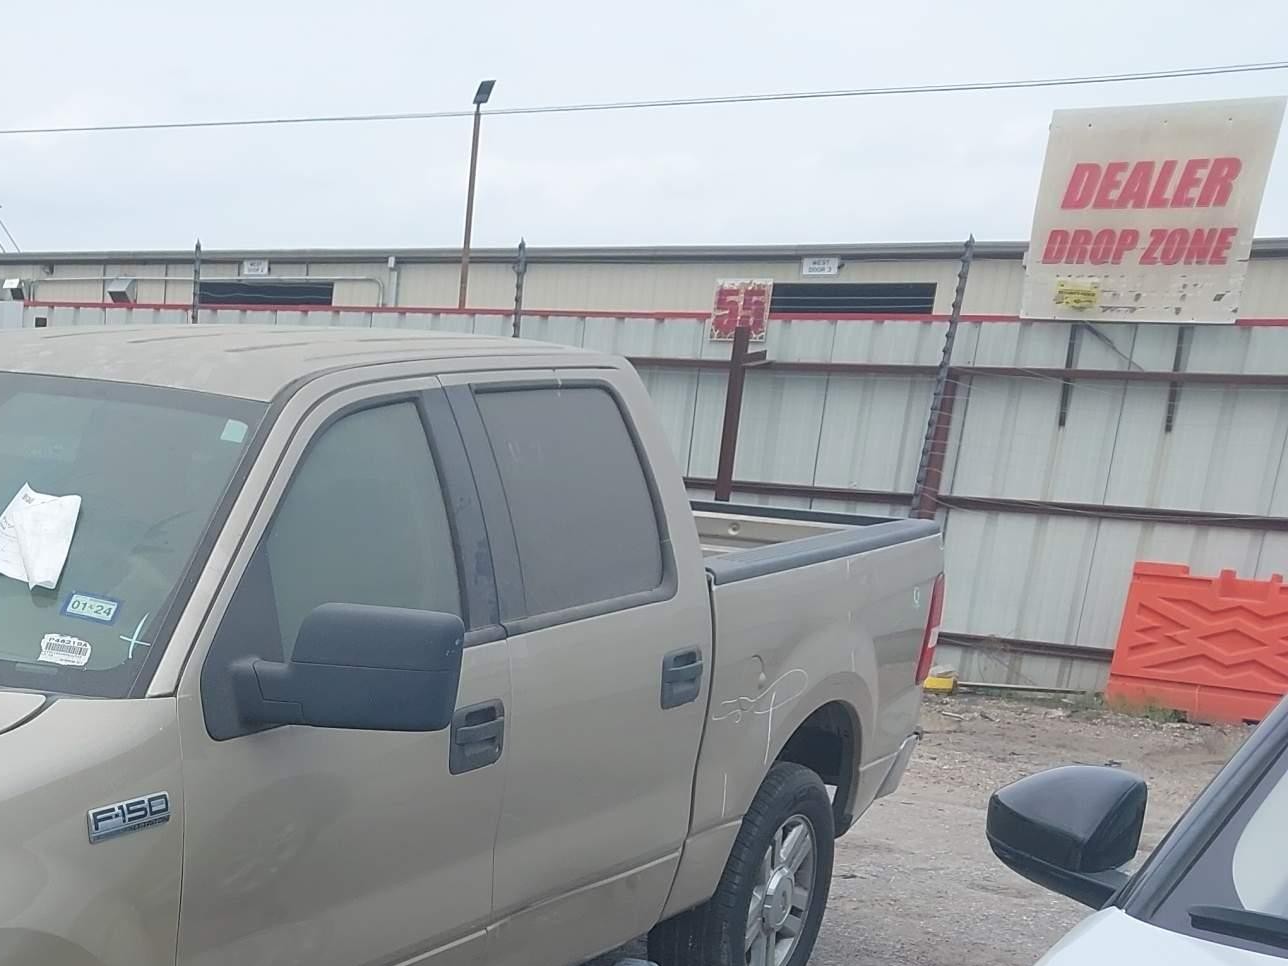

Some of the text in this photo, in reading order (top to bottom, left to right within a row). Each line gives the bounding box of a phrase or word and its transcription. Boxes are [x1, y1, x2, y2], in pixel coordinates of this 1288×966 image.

[1060, 157, 1242, 210] DEALER
[1041, 227, 1239, 265] DROP ZONE
[714, 286, 766, 336] 55
